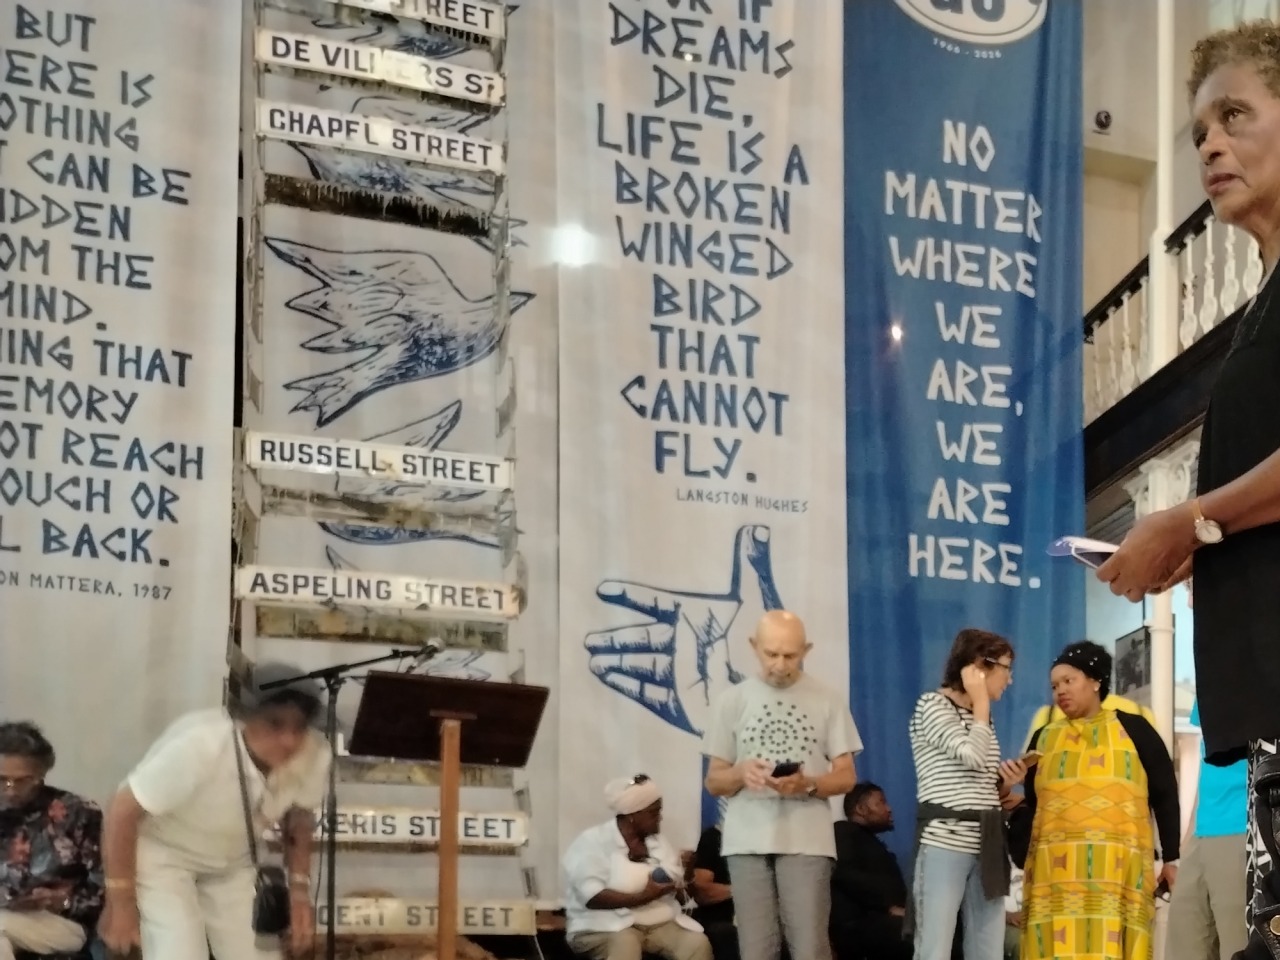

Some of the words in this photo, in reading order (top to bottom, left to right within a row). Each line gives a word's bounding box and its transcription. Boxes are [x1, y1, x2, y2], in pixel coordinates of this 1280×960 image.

[16, 4, 97, 51] BUT
[272, 36, 310, 63] DE
[608, 2, 795, 79] DREAMS
[121, 70, 155, 108] IS
[0, 92, 139, 152] OTHING
[392, 129, 492, 166] STREET
[597, 103, 702, 165] LIFE
[728, 130, 765, 175] IS
[783, 144, 810, 186] A
[943, 119, 995, 172] NO
[27, 149, 110, 193] CAN
[133, 163, 191, 205] BE
[615, 160, 790, 234] BROKEN
[884, 170, 1043, 243] MATTER
[71, 244, 154, 290] THE
[615, 214, 794, 280] WINGED
[888, 236, 1038, 298] WHERE
[653, 273, 761, 327] BIRD
[935, 302, 1002, 348] WE
[0, 328, 73, 371] ING
[93, 339, 193, 387] THAT
[651, 323, 761, 379] THAT
[620, 375, 789, 436] CANNOT
[927, 358, 1024, 417] ARE,
[62, 427, 203, 480] REACH
[260, 439, 387, 473] RUSSELL
[403, 454, 500, 484] STREET
[655, 430, 757, 483] FLY.
[936, 420, 1003, 466] WE
[131, 481, 180, 524] OR
[676, 487, 749, 507] LANGSTON
[755, 495, 809, 513] HUGHES
[927, 477, 1012, 526] ARE
[42, 518, 170, 567] BACK.
[908, 533, 1041, 589] HERE.
[133, 583, 172, 601] 1987
[249, 572, 392, 600] ASPELING
[405, 580, 505, 610] STREET
[410, 816, 516, 839] STEET
[407, 906, 514, 928] STEET
